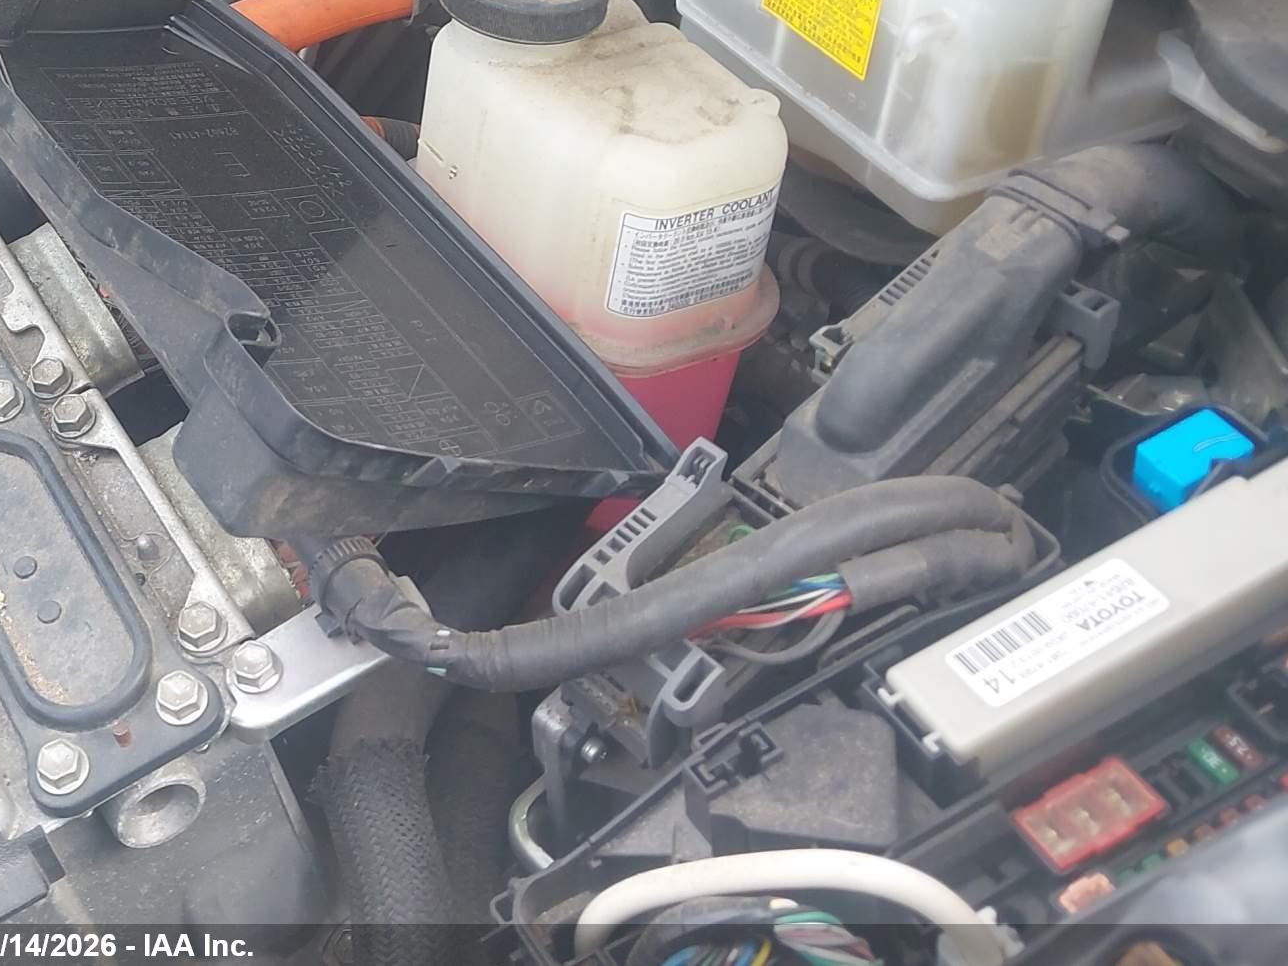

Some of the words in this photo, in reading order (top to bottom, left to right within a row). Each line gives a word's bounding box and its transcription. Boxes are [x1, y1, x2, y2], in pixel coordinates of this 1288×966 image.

[655, 208, 714, 231] INVERTER
[722, 189, 776, 215] COOLANT
[1076, 591, 1145, 631] TOYOTA
